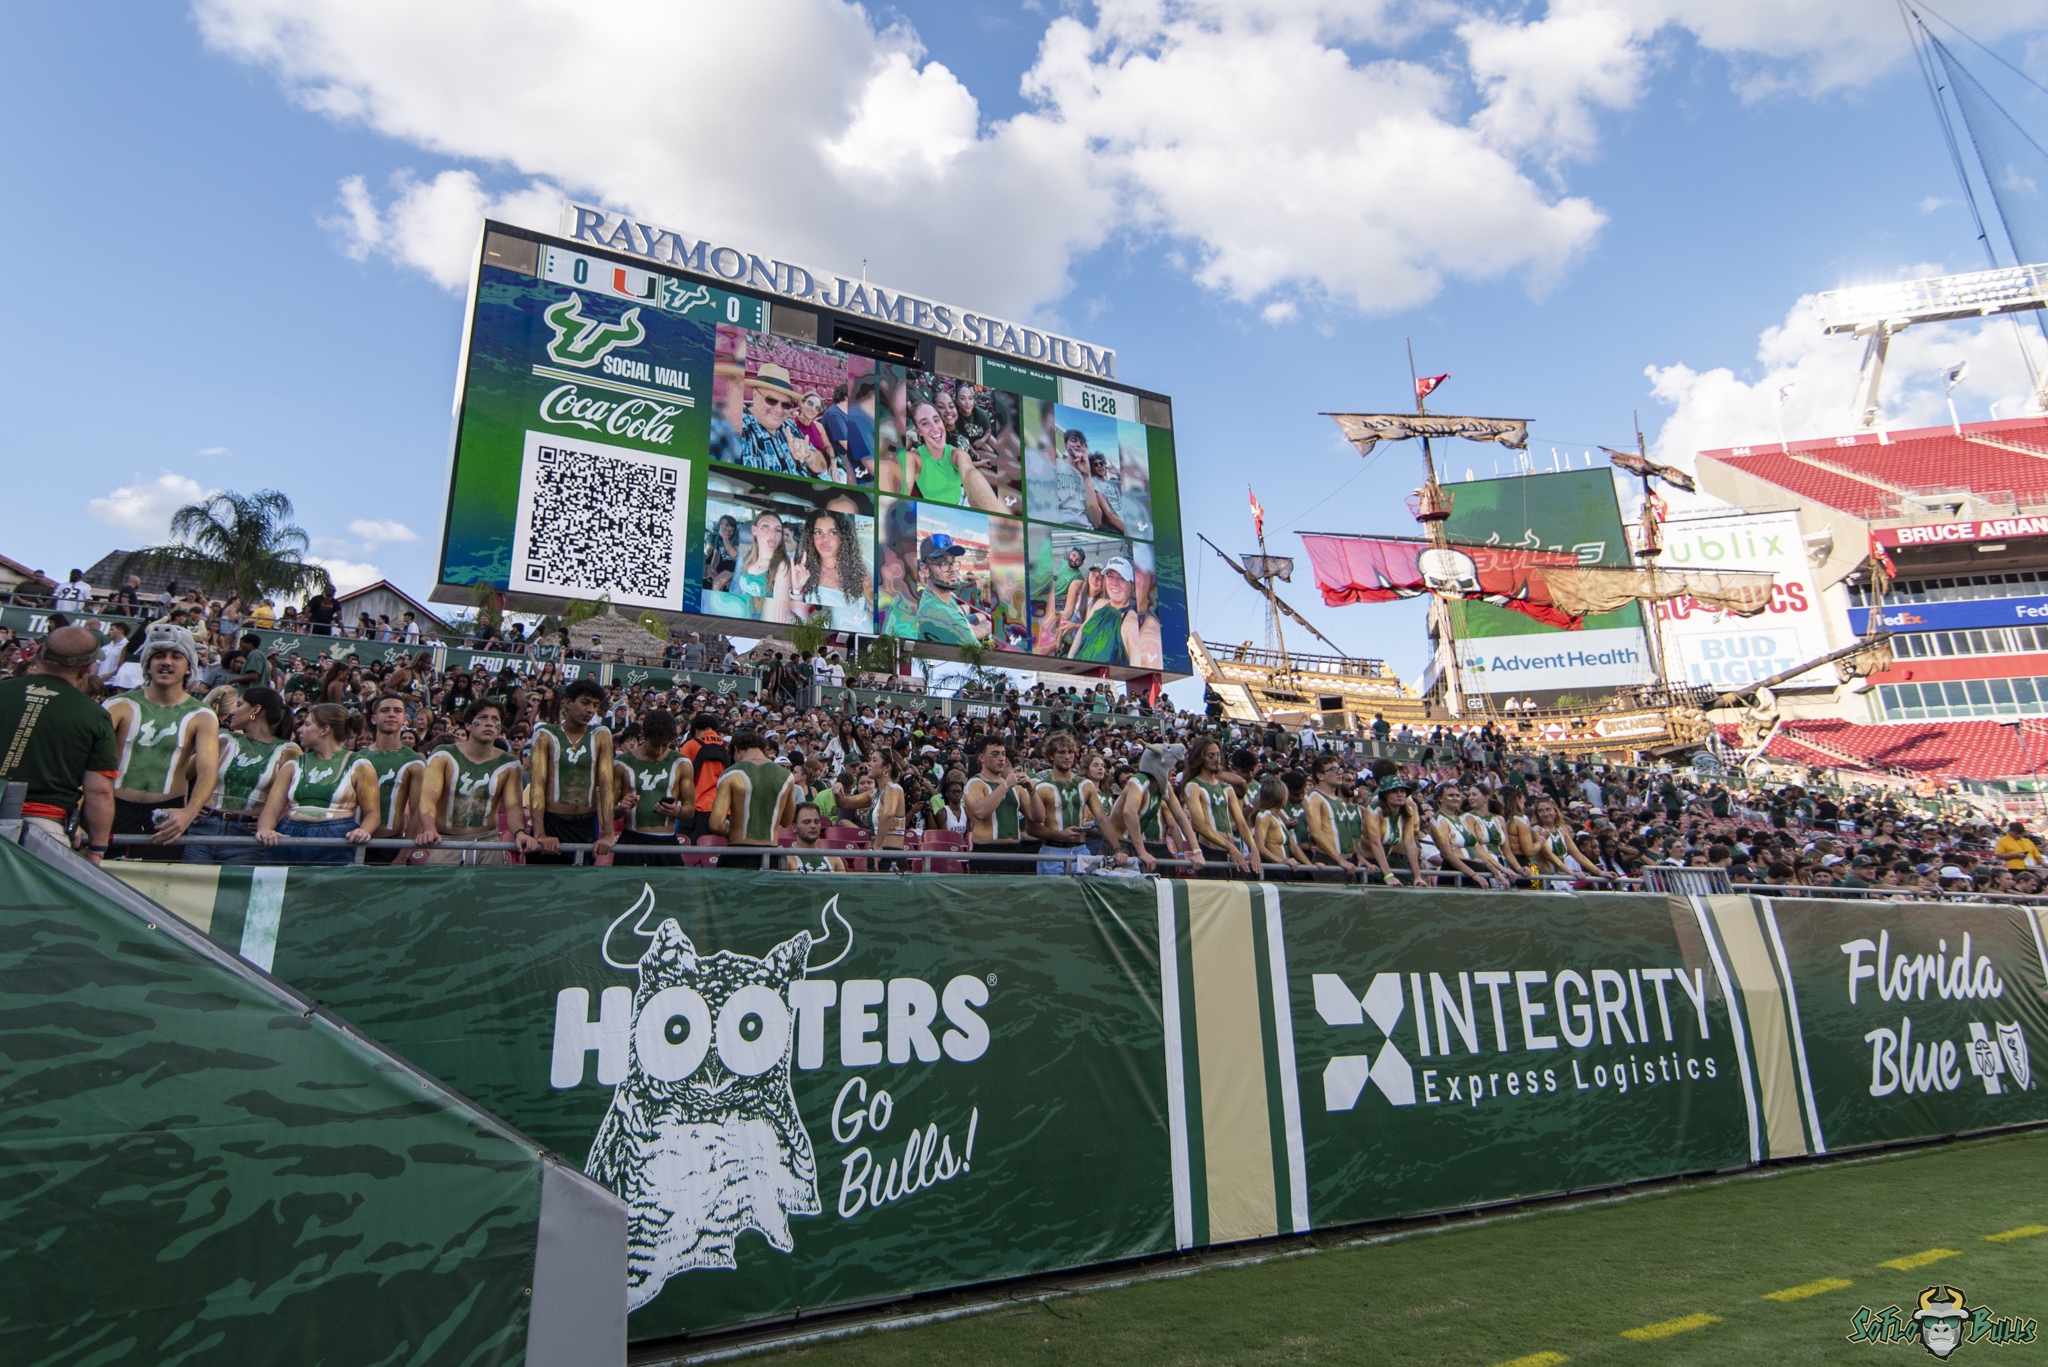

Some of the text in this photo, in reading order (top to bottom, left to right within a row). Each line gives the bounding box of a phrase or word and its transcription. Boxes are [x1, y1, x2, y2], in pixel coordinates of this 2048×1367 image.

[574, 258, 588, 284] 0
[570, 205, 1115, 379] RAYMOND JAMES STADIUM
[727, 297, 740, 322] 0
[602, 355, 691, 391] SOCIAL WALL
[987, 360, 1006, 369] DOWN
[1082, 391, 1116, 415] 61:28
[1084, 385, 1113, 396] PREGAME
[539, 384, 684, 444] Coca-Cola
[1731, 447, 1751, 456] 344
[1896, 517, 2048, 543] BRUCE ARIAN
[1637, 530, 1784, 564] ublix
[62, 587, 80, 600] 93
[1491, 647, 1640, 672] AdventHealth
[1700, 635, 1777, 660] BUD
[468, 655, 504, 673] HERD
[1690, 657, 1795, 685] LIGHT
[966, 704, 989, 719] HERD
[1469, 699, 1482, 708] CC
[1840, 929, 2003, 1005] Florida
[1410, 968, 1710, 1056] INTEGRITY
[550, 974, 991, 1089] HOOTERS
[1864, 1016, 1961, 1097] Blue
[1423, 1052, 1717, 1106] Express Logistics
[831, 1076, 894, 1144] Go
[837, 1106, 978, 1218] Bulls!
